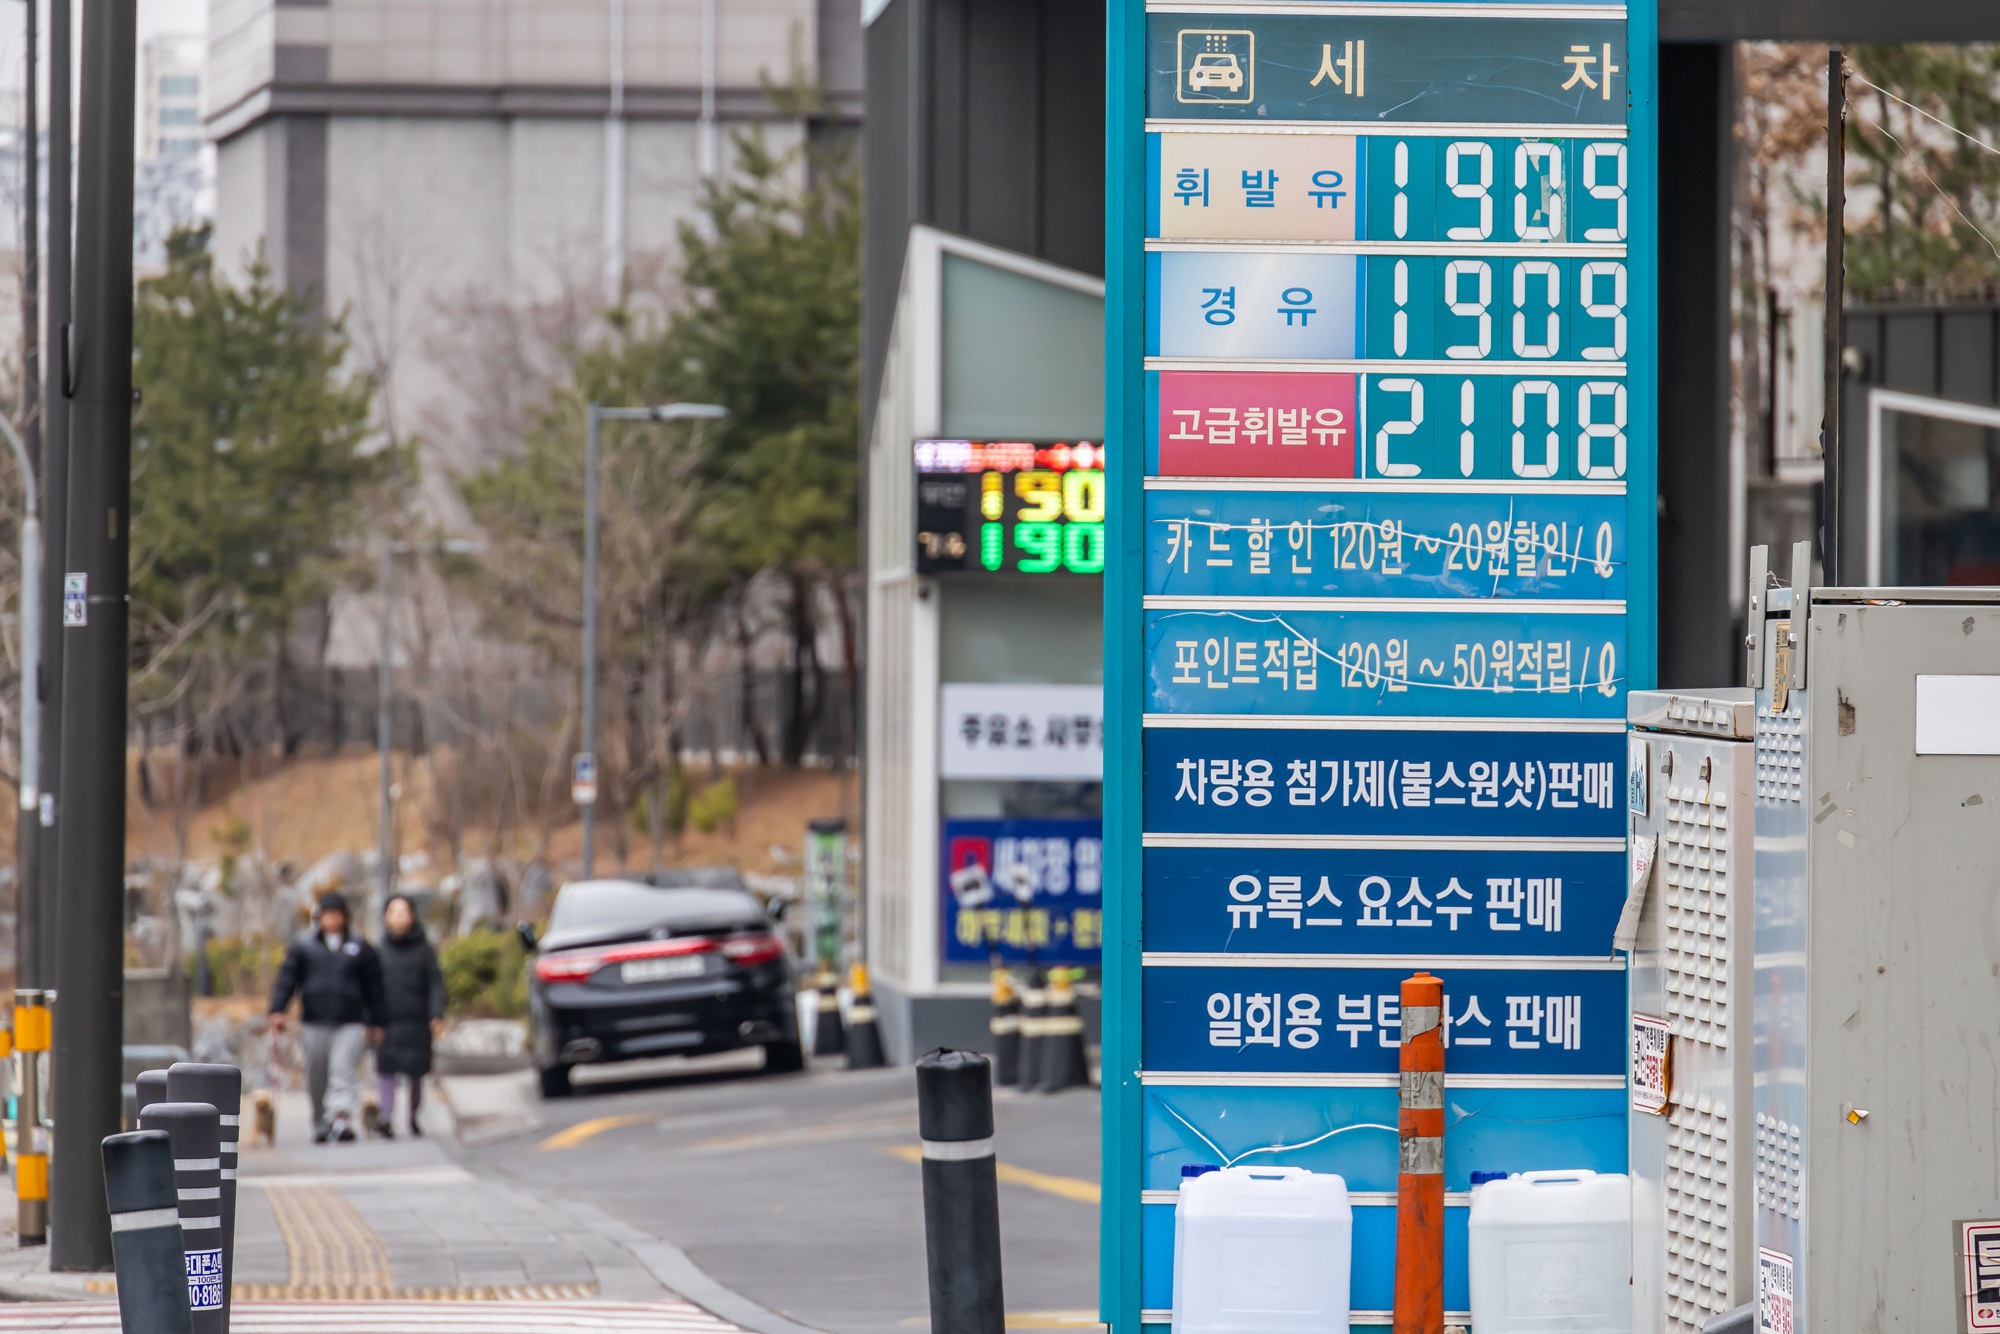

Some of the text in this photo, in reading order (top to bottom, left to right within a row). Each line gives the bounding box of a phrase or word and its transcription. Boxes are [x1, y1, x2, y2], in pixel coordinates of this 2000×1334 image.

[1395, 141, 1627, 240] 1909
[1395, 259, 1627, 360] 1909
[1169, 378, 1627, 479] 고급휘발유 2108
[1172, 636, 1317, 691] 포인트적립
[1046, 713, 1103, 748] 사무
[1175, 759, 1275, 807] 차량용
[1227, 875, 1562, 932] 유록스 요소수 판매
[1207, 992, 1322, 1049] 일회용
[1505, 995, 1581, 1050] 판매
